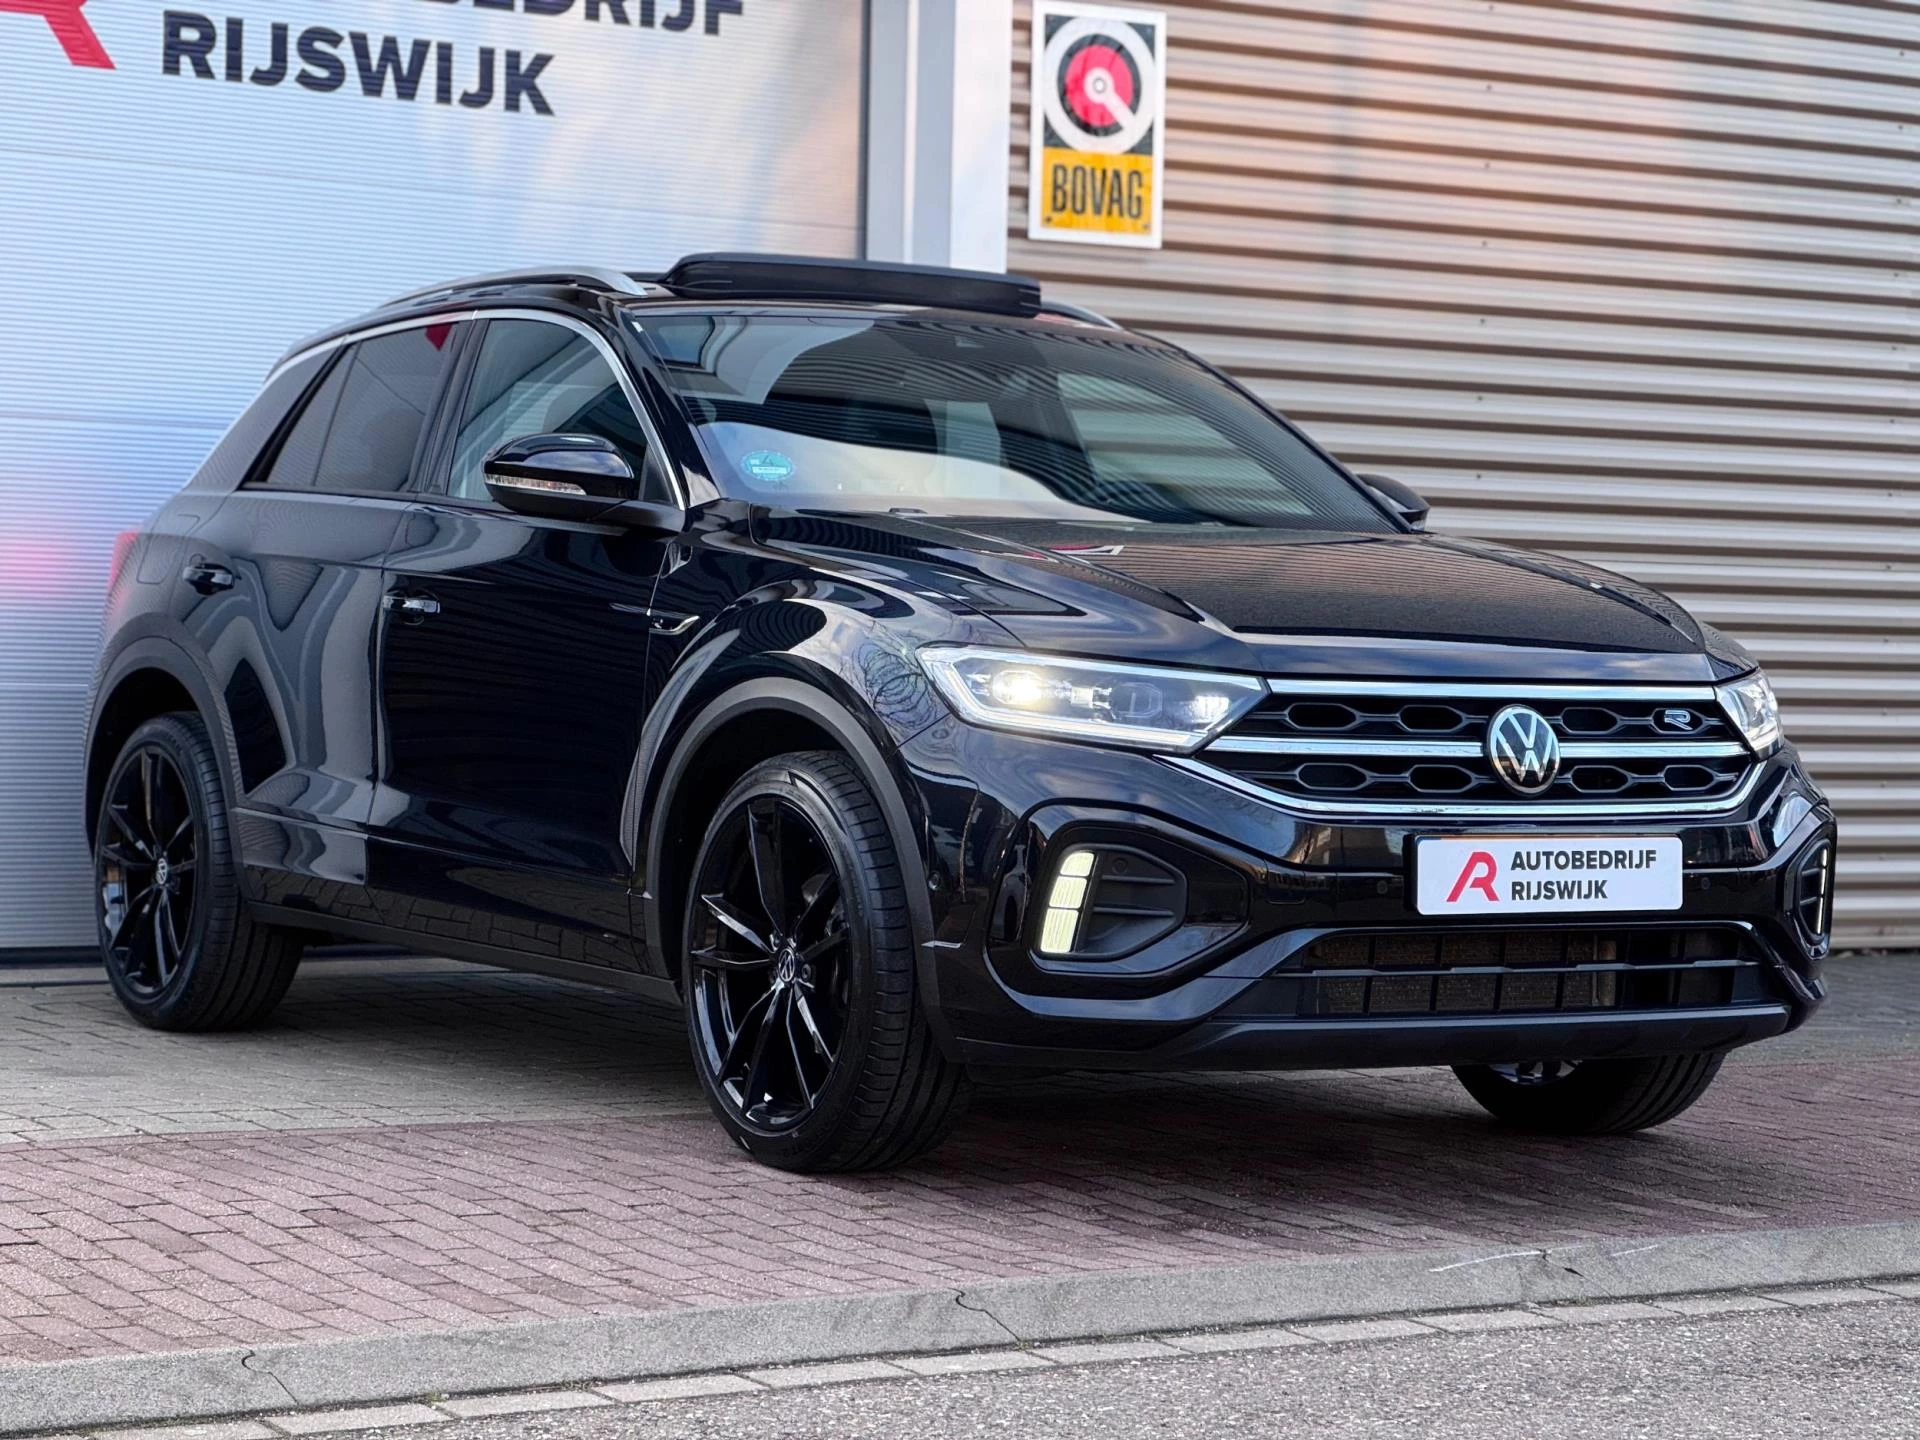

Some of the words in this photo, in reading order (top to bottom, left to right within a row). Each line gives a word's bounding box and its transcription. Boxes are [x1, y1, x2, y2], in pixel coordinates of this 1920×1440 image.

[162, 9, 555, 117] RIJSWIJK
[1052, 163, 1144, 220] BOVAG
[1510, 849, 1657, 871] AUTOBEDRIJF
[1510, 879, 1608, 901] RIJSWIJK
